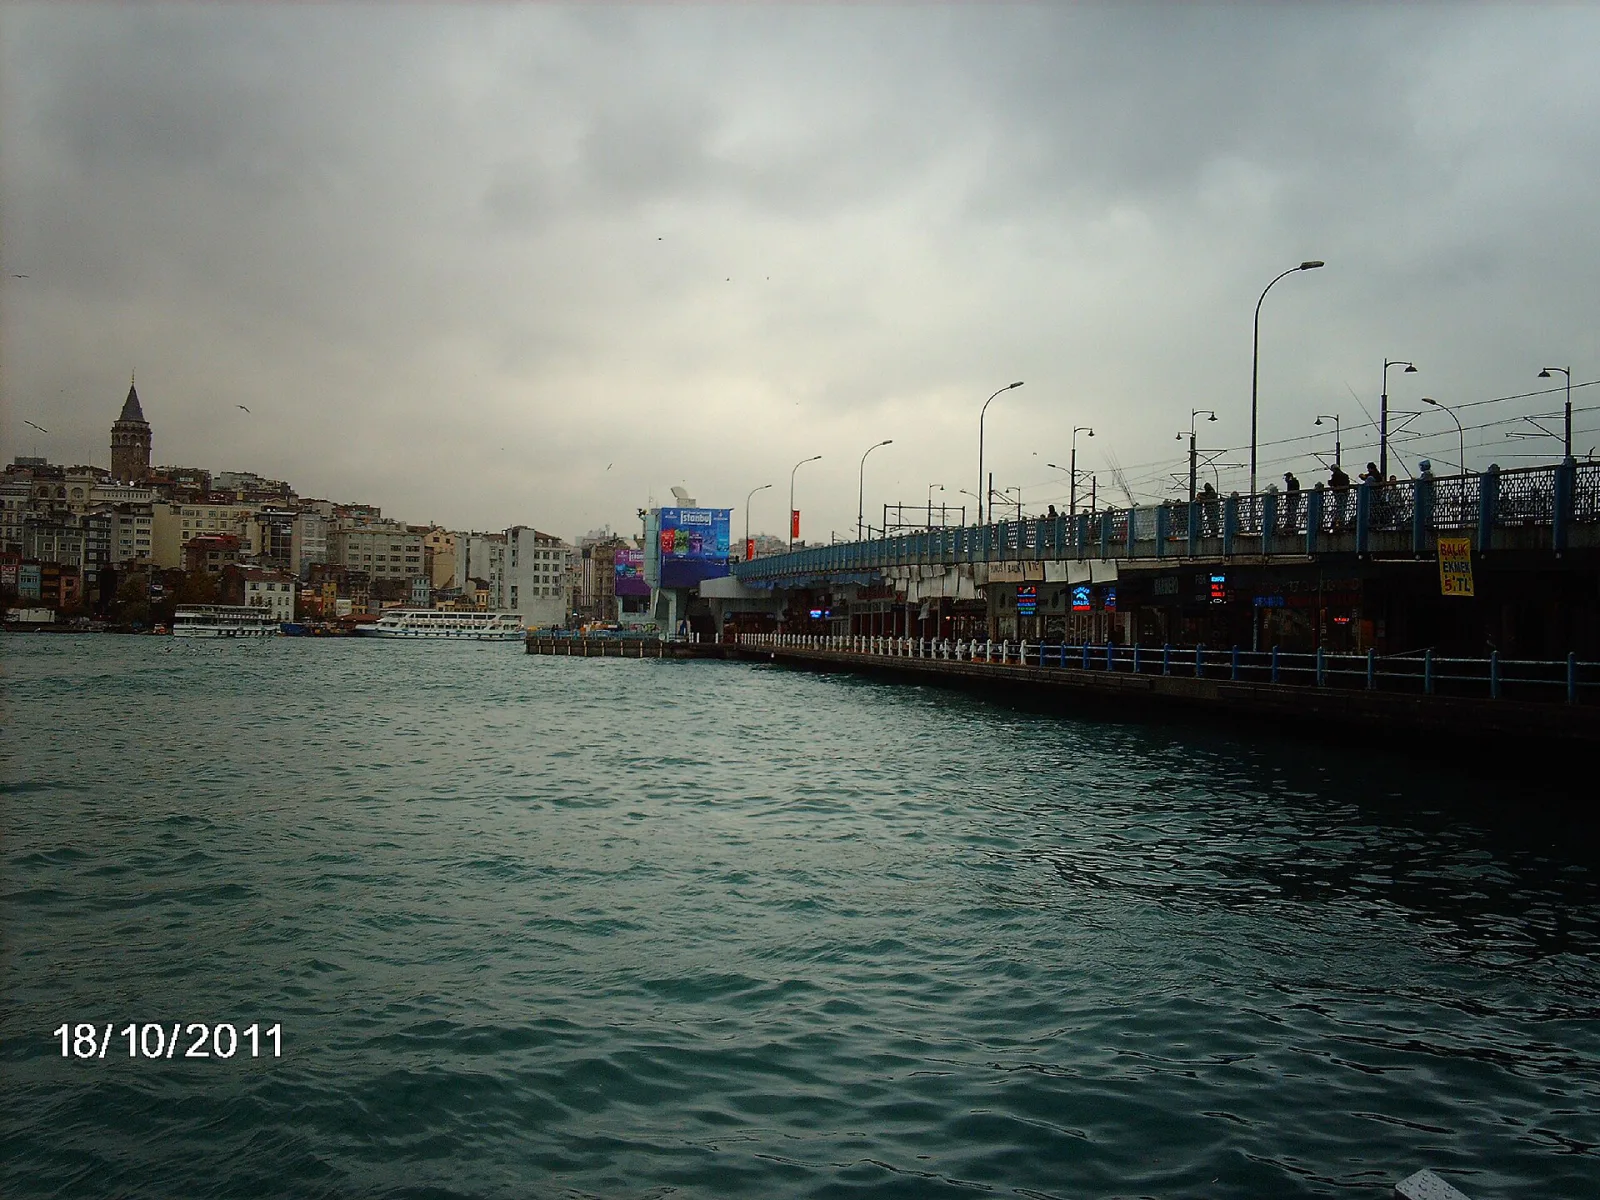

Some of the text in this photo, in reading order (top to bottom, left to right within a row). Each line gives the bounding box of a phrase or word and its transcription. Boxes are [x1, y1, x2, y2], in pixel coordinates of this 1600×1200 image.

[1441, 544, 1467, 556] BALIK
[1443, 562, 1470, 573] EKMEK
[1445, 578, 1470, 591] 5 TL
